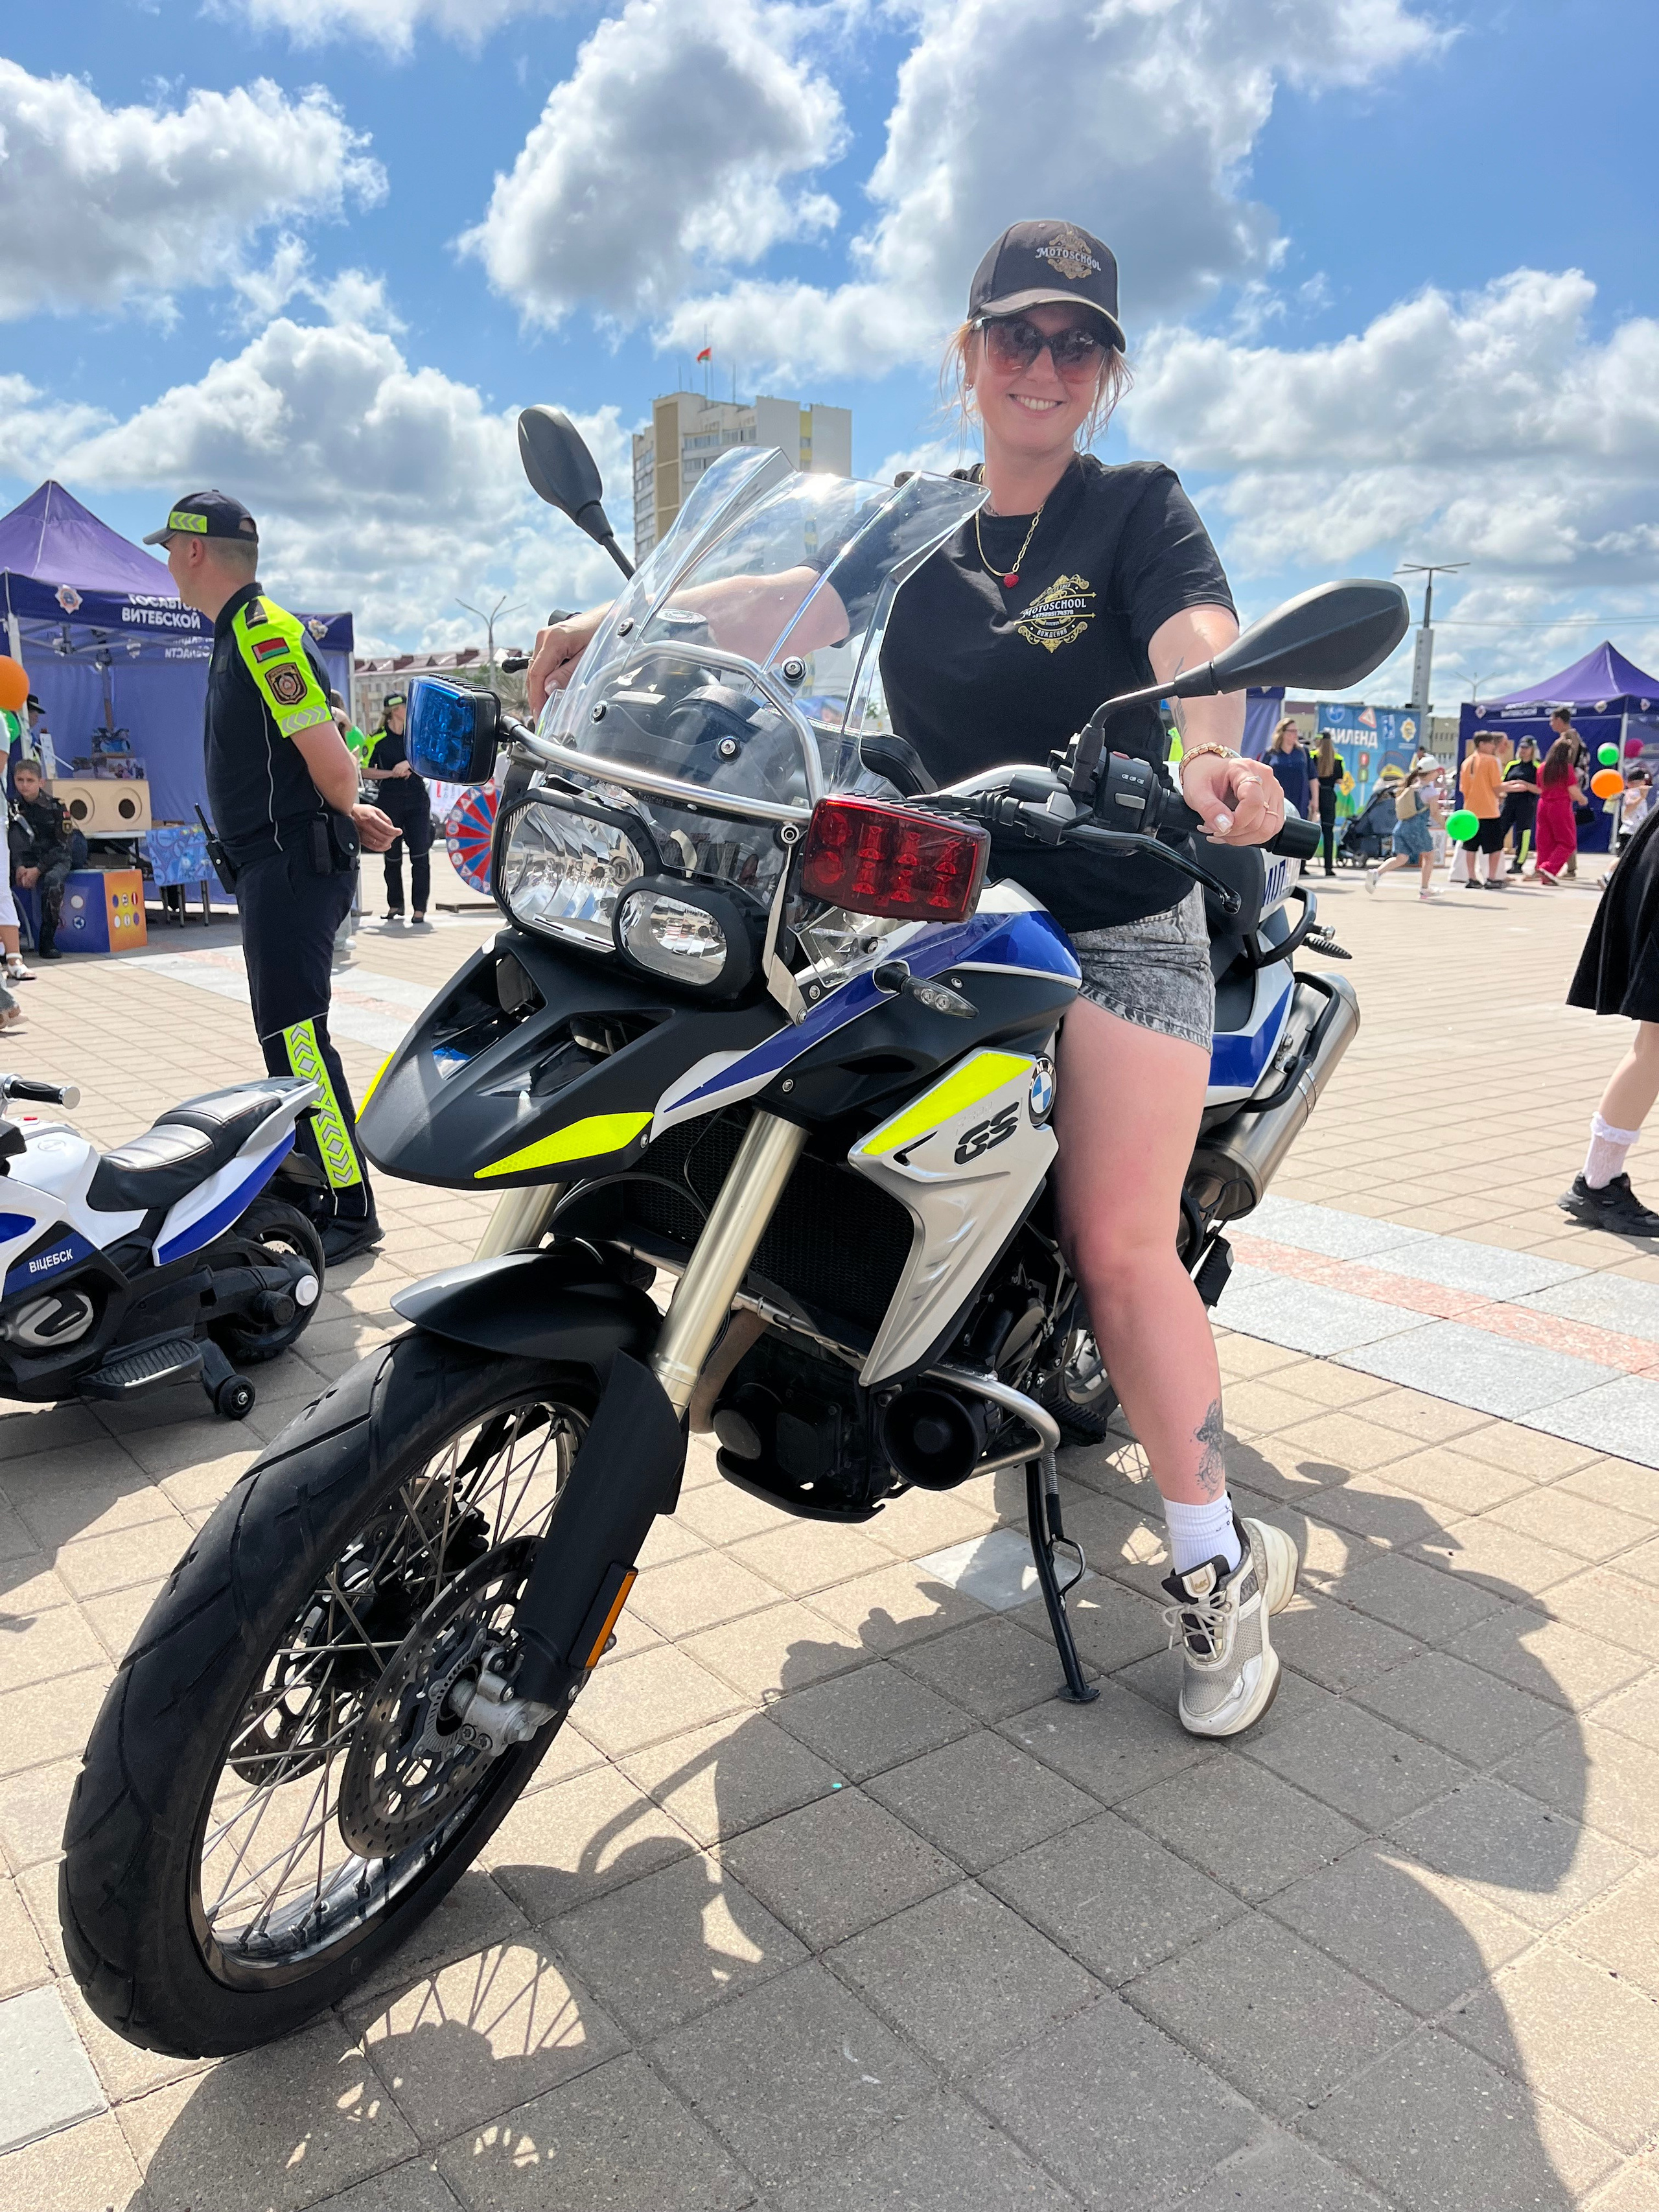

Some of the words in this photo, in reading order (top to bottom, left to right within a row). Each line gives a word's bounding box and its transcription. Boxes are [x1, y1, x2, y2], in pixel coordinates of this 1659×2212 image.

[1035, 247, 1102, 272] MOTOSCHOOL
[122, 607, 201, 630] ВИТЕБСКОЙ
[1020, 598, 1087, 620] MOTOSCHOOL
[1036, 627, 1068, 638] ВОЖДЕНИЯ
[1029, 1060, 1054, 1090] BMW
[954, 1101, 1019, 1165] GS
[29, 1248, 73, 1274] ВІЦЕБСК
